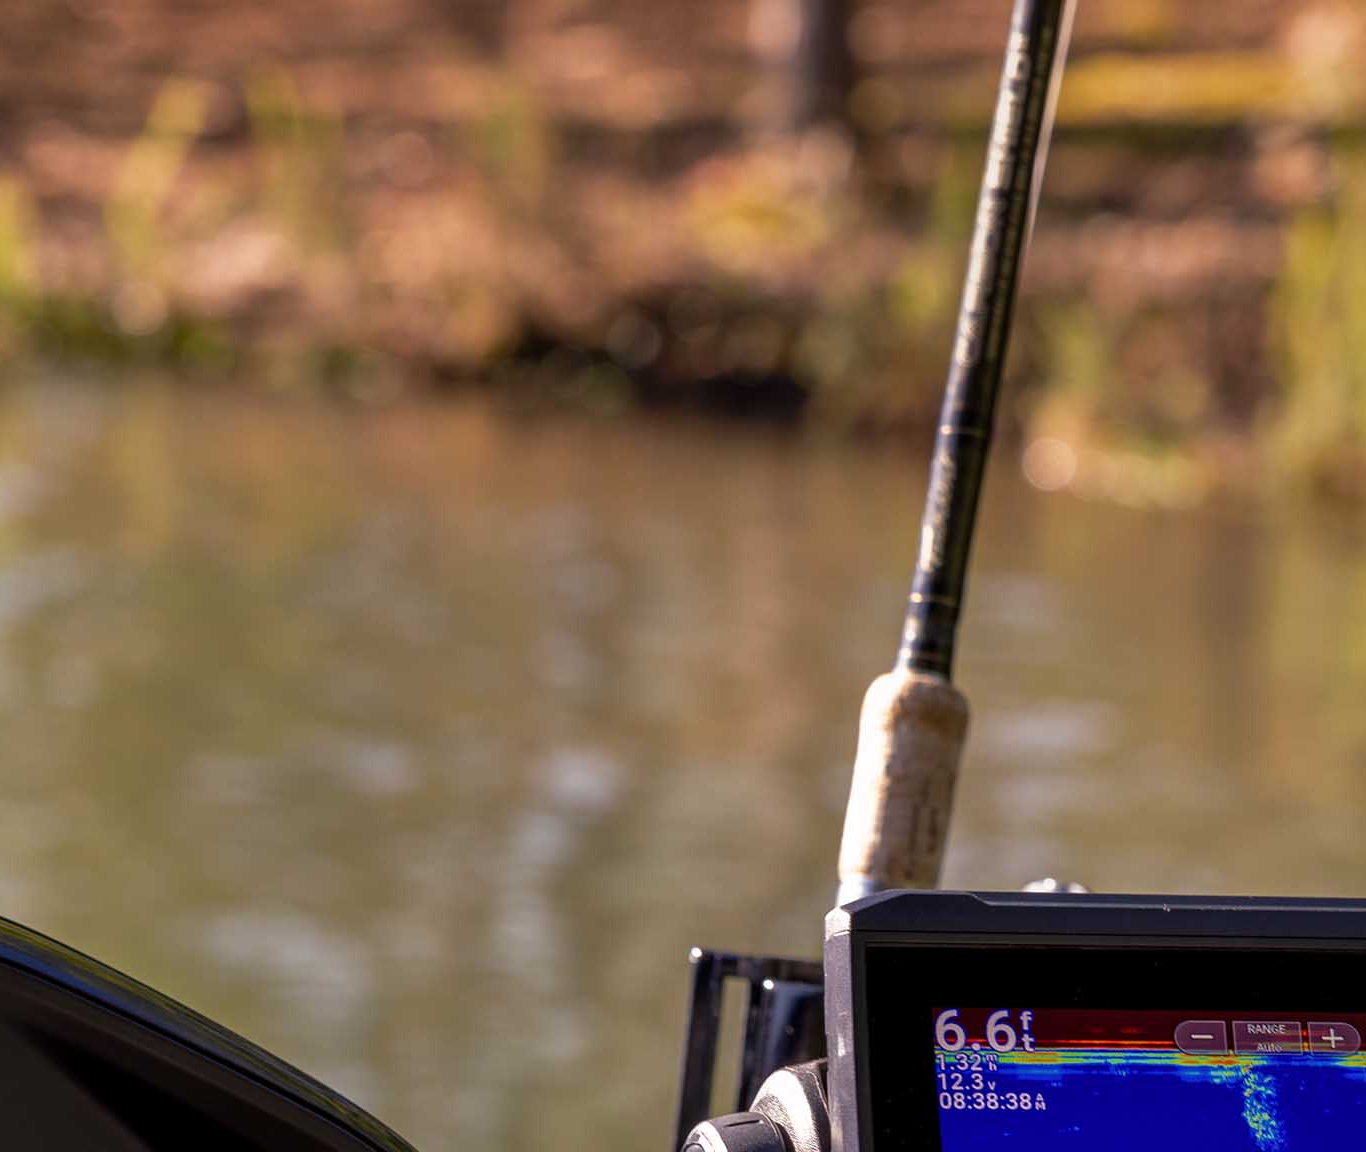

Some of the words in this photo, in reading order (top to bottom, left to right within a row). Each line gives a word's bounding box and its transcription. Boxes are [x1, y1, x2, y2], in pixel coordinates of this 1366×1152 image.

[936, 1009, 1017, 1052] 6.6
[1247, 1023, 1286, 1034] RANGE
[938, 1054, 984, 1071] 1.32
[938, 1073, 984, 1090] 12.3
[939, 1092, 1033, 1110] 08:38:38
